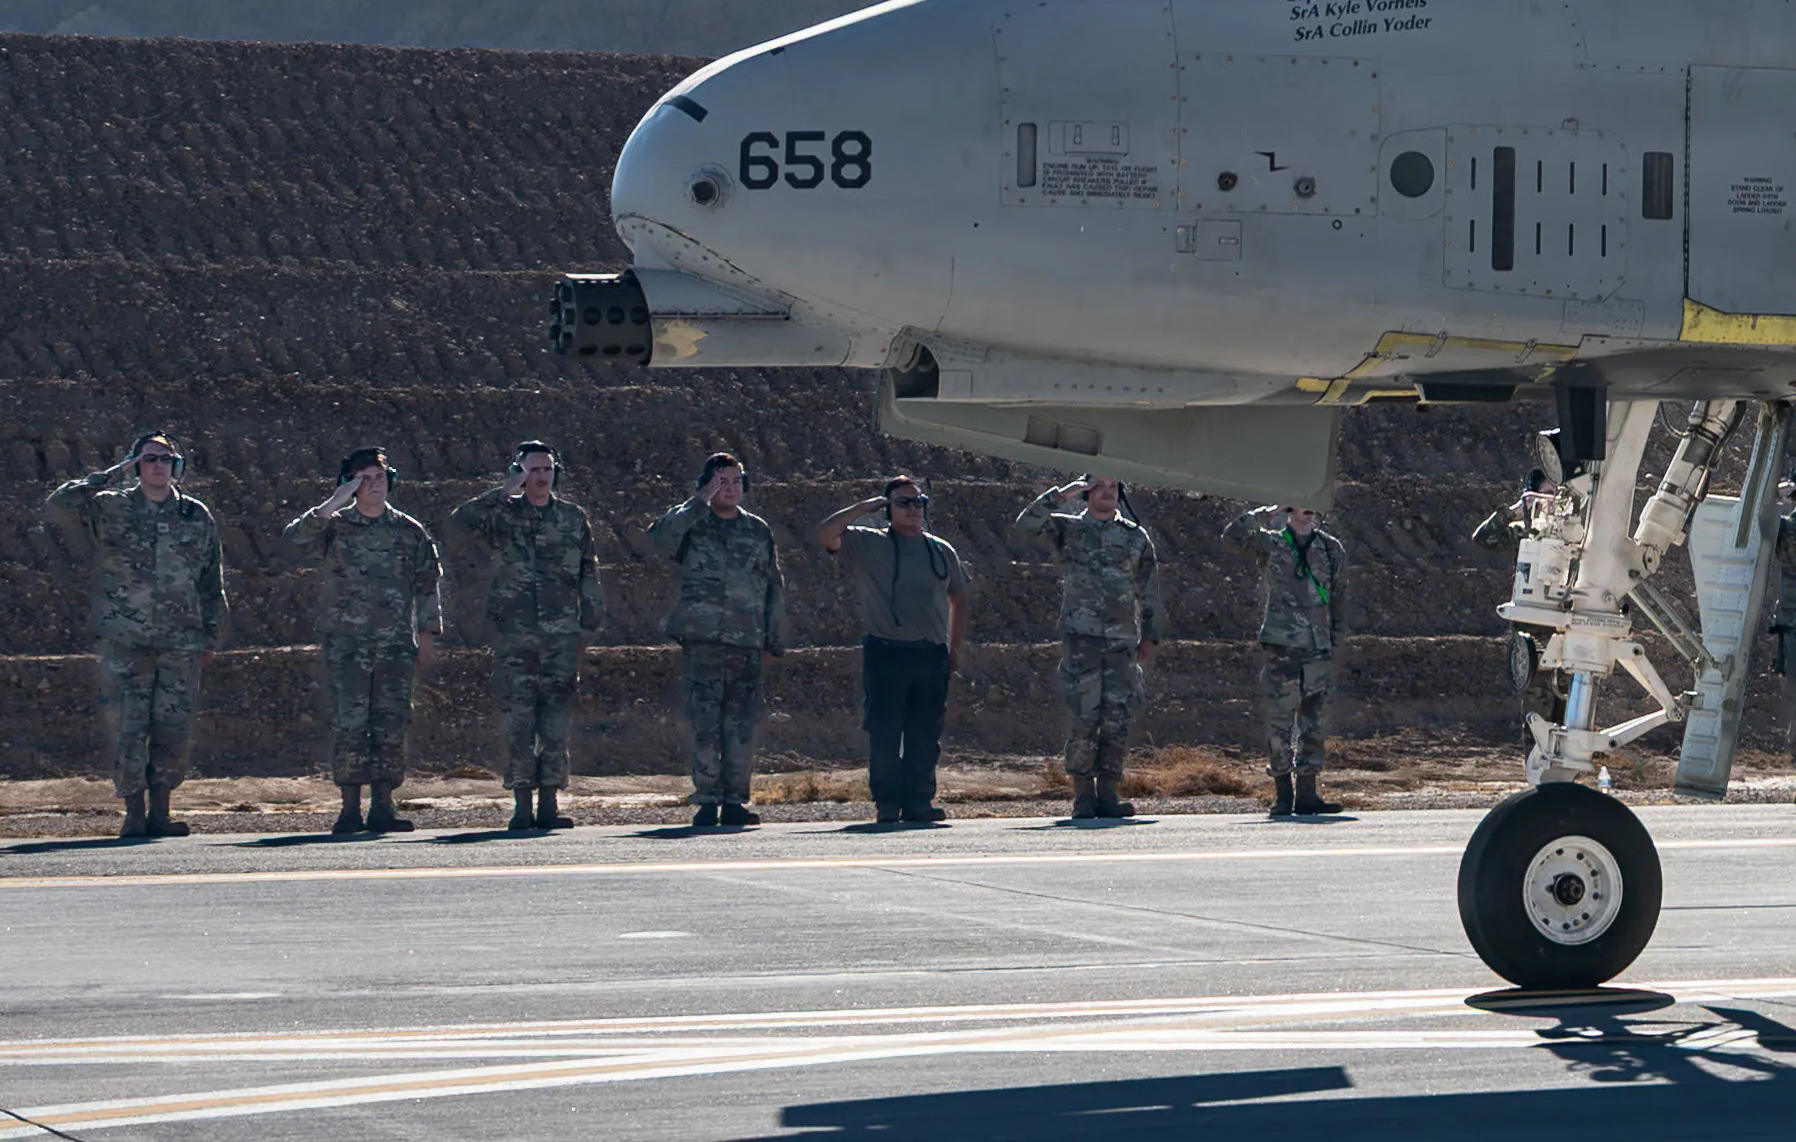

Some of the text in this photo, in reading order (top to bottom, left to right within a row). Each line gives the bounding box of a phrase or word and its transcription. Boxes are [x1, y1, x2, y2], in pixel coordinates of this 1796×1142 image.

[1290, 4, 1319, 21] SrA
[1325, 0, 1360, 21] Kyle
[1294, 14, 1432, 42] SrA Collin Yoder
[739, 130, 872, 189] 658
